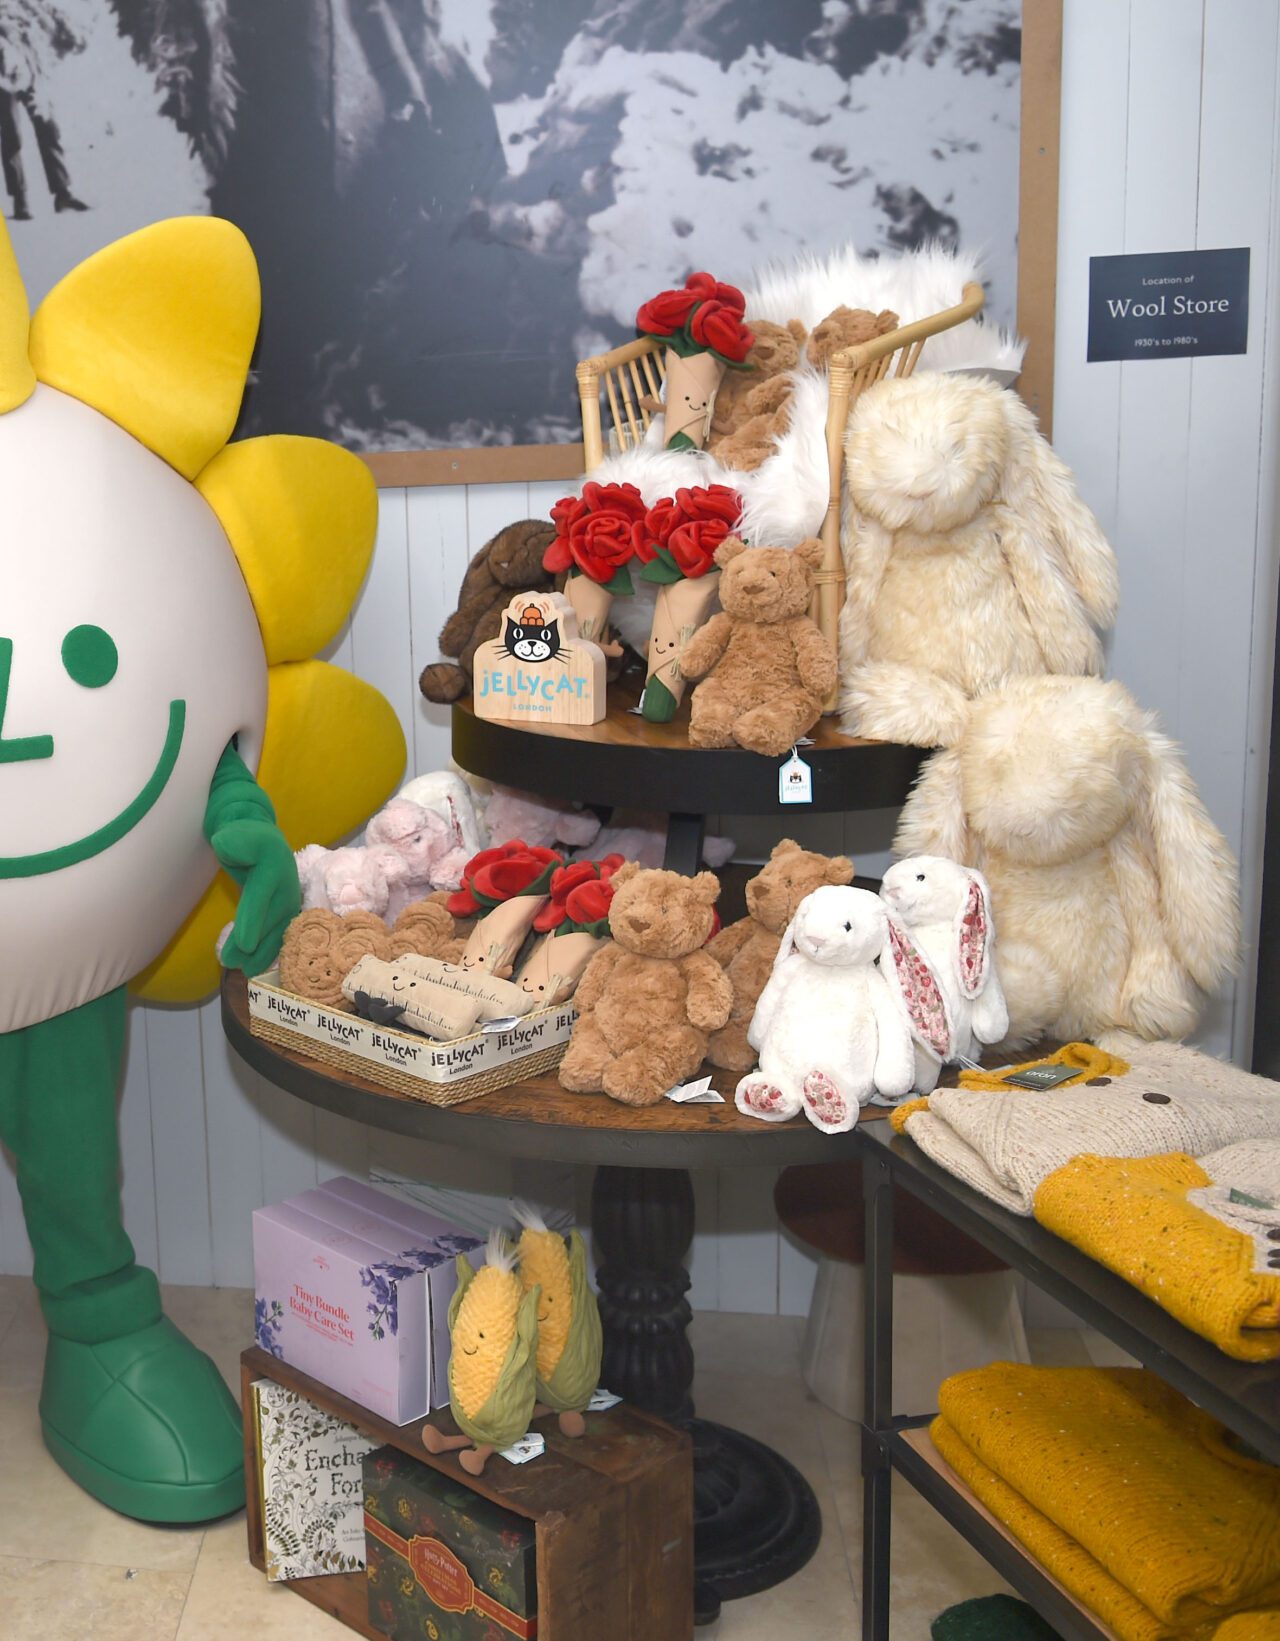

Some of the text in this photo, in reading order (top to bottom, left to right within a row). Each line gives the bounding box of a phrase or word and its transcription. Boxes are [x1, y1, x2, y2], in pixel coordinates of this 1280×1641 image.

[1142, 275, 1194, 286] Location of
[1107, 295, 1230, 318] Wool Store
[1135, 338, 1160, 347] 1930's
[1173, 336, 1198, 345] 1980's
[512, 704, 552, 712] LONDON
[279, 1014, 298, 1027] London
[330, 1034, 351, 1046] London
[510, 1043, 533, 1055] London
[385, 1053, 407, 1066] London
[449, 1062, 473, 1075] London
[293, 1284, 350, 1323] Tiny Bundle
[289, 1296, 314, 1318] Baby
[314, 1310, 337, 1330] Care
[338, 1324, 355, 1341] Set
